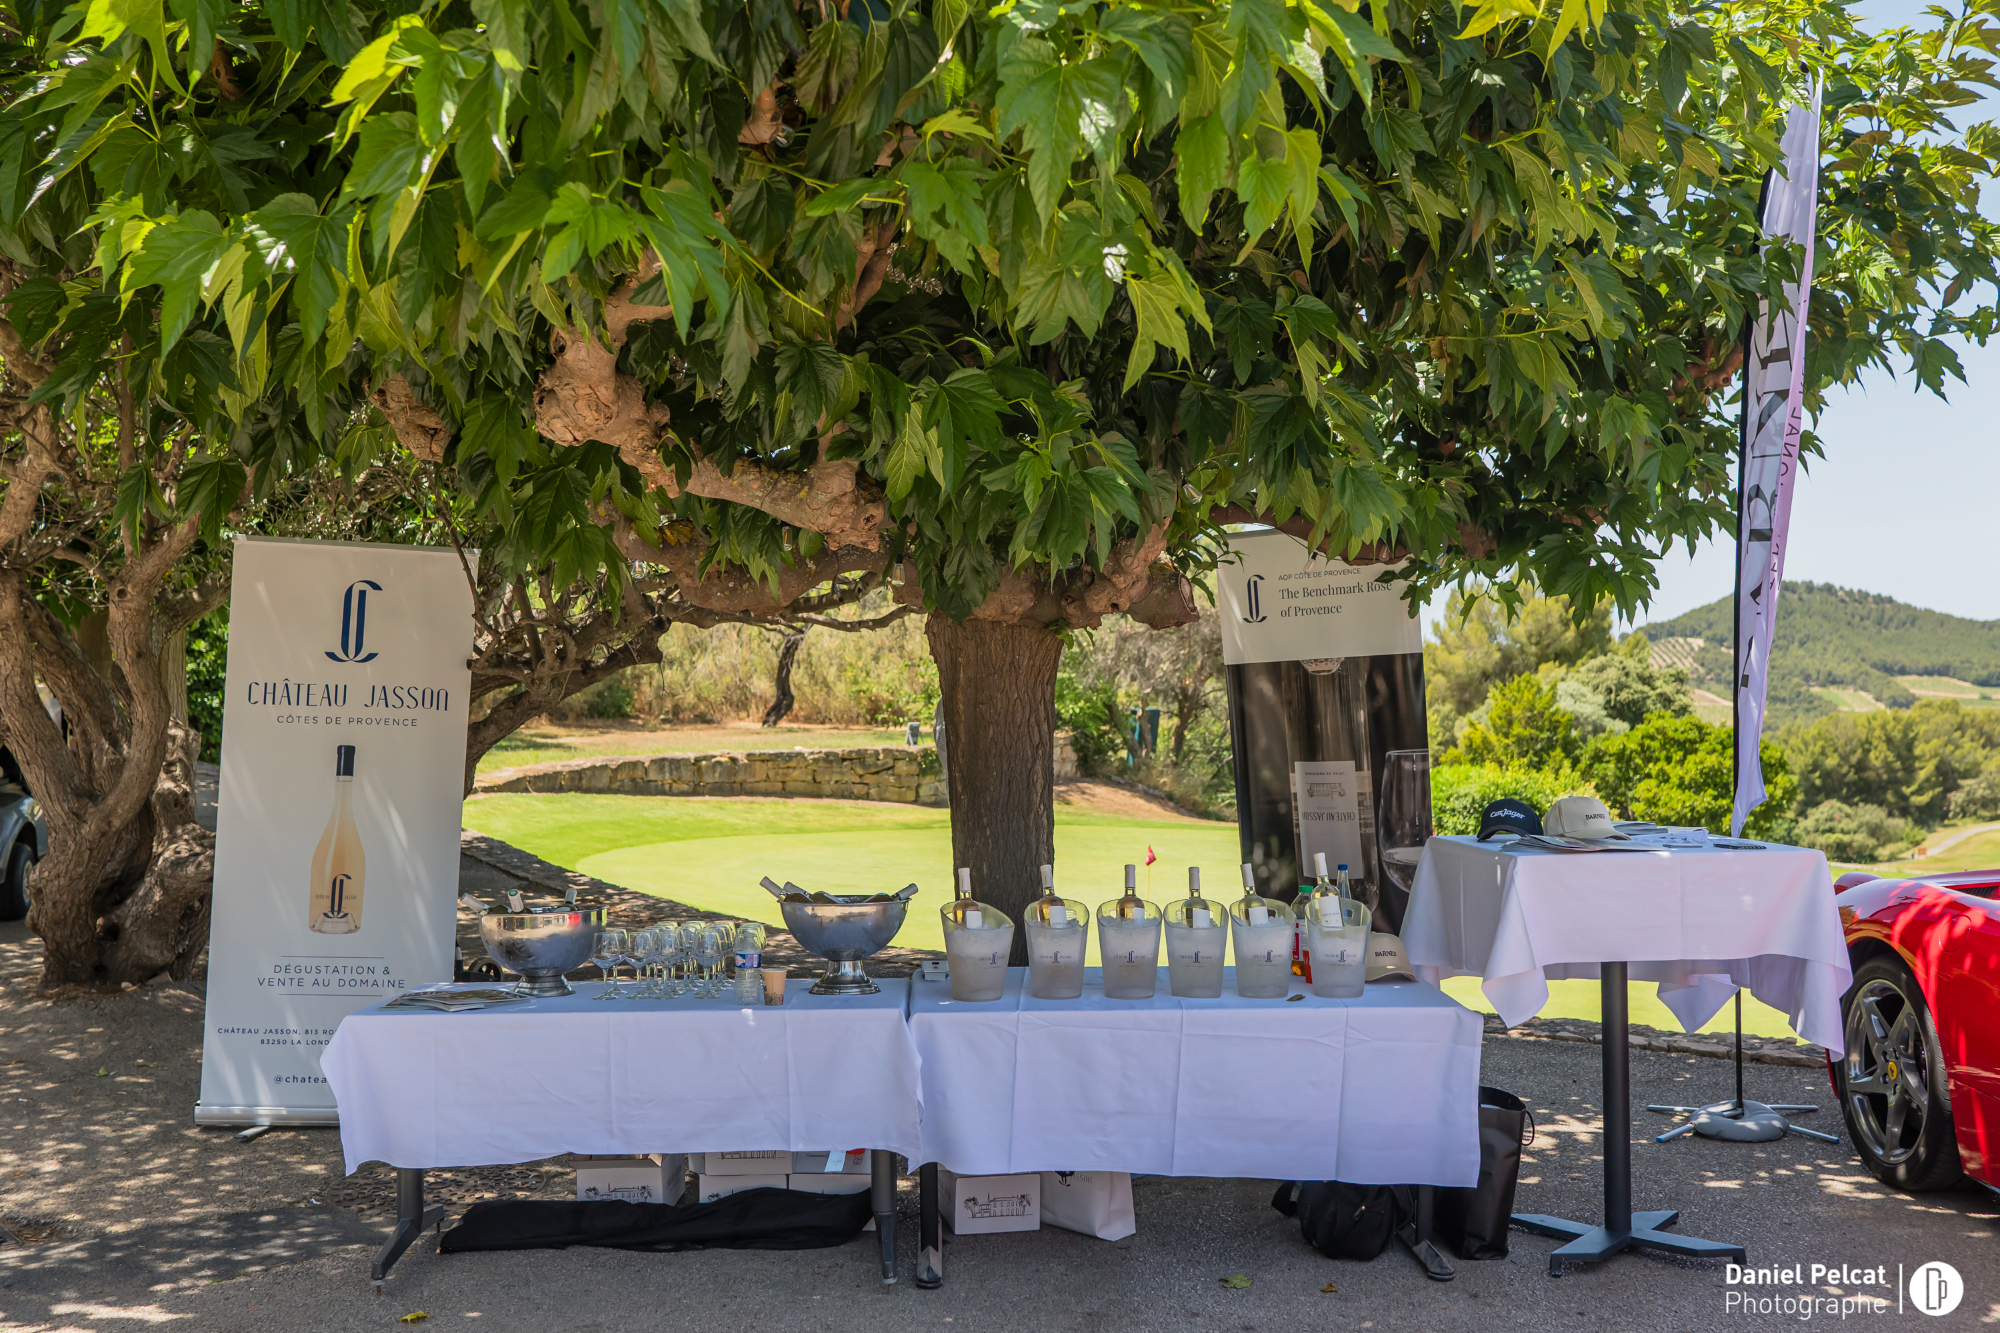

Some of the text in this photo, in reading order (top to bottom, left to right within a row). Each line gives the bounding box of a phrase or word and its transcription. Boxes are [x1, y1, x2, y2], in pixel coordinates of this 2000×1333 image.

[1323, 567, 1362, 577] PROVENCE
[1278, 587, 1300, 600] The
[1302, 581, 1364, 598] Benchmark
[1280, 604, 1343, 618] of Provence
[247, 677, 349, 708] CHÂTEAU
[276, 713, 418, 727] CÔTES DE PROVENCE
[273, 962, 391, 976] DÉGUSTATION &
[257, 977, 406, 989] VENTE AU DOMAINE
[217, 1026, 260, 1035] CHÂTEAU
[262, 1028, 301, 1036] JASSON,
